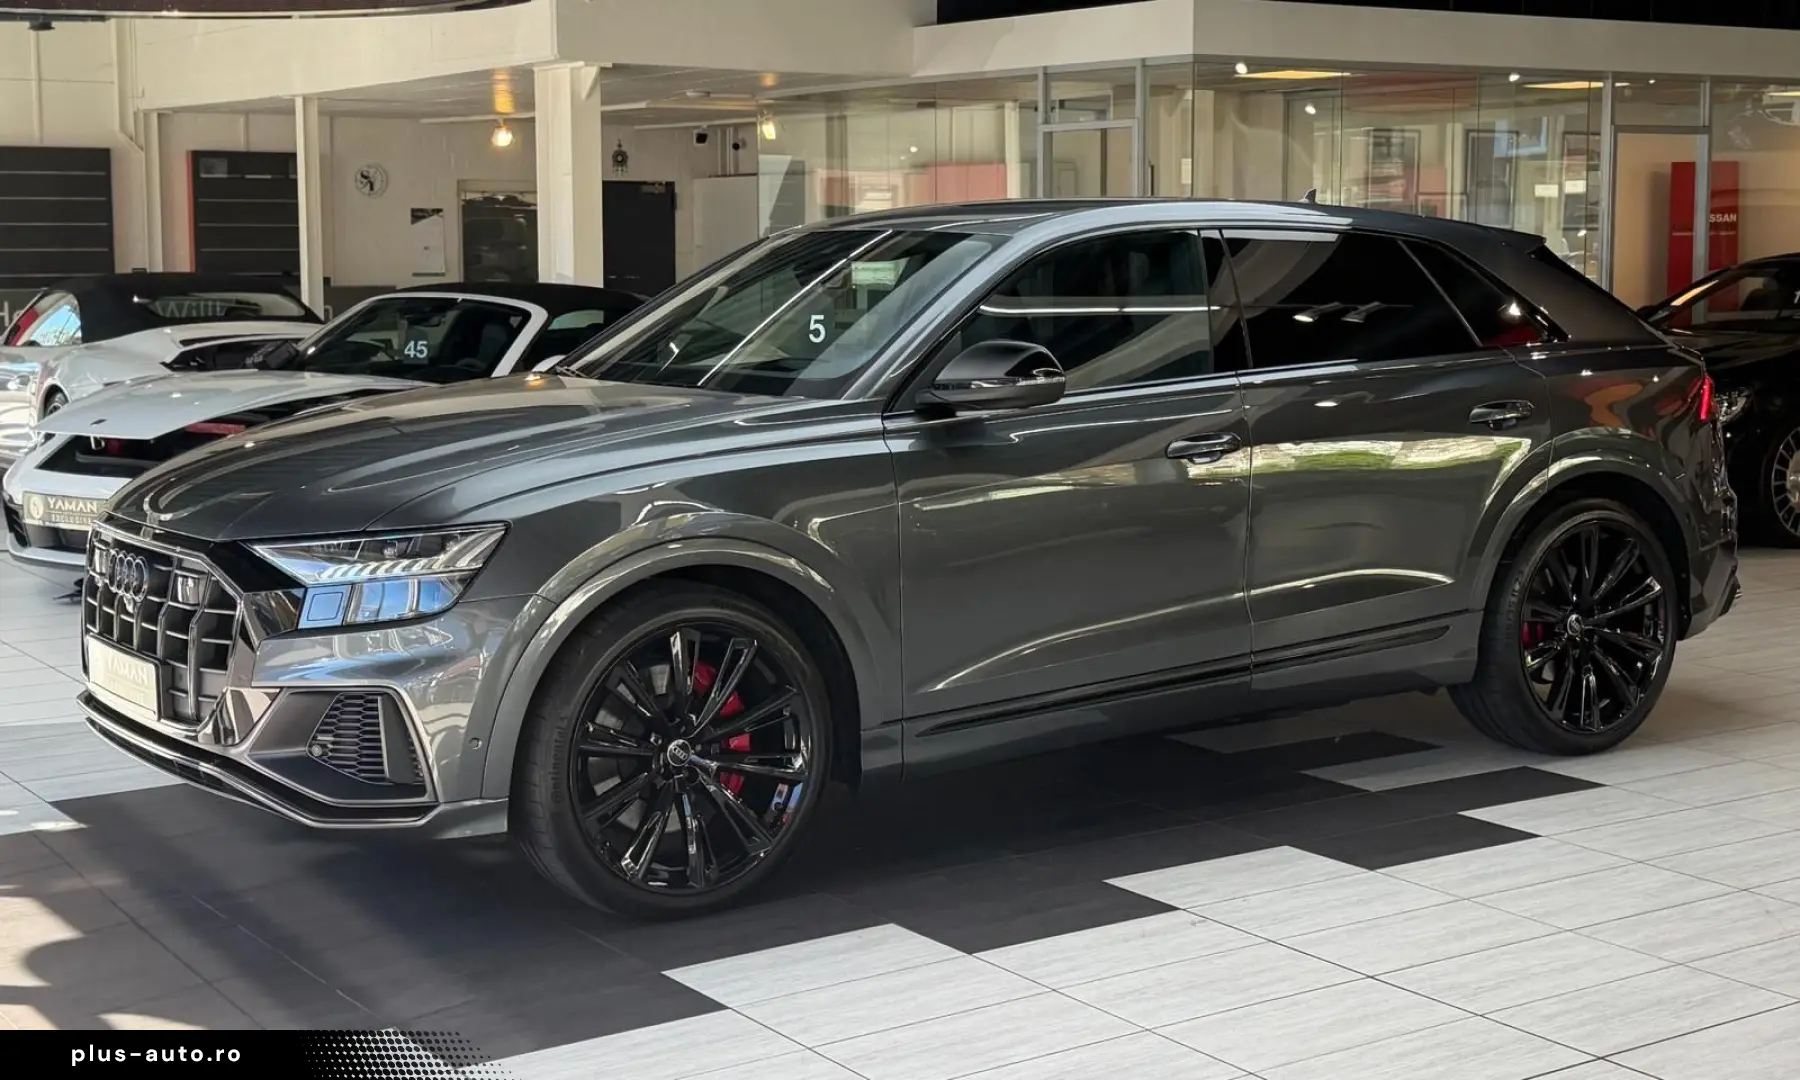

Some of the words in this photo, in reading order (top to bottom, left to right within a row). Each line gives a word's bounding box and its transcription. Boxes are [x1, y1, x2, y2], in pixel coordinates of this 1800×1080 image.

[1709, 213, 1737, 222] SSAN
[808, 314, 826, 343] 5
[404, 340, 428, 358] 45
[48, 496, 98, 513] YAMAN
